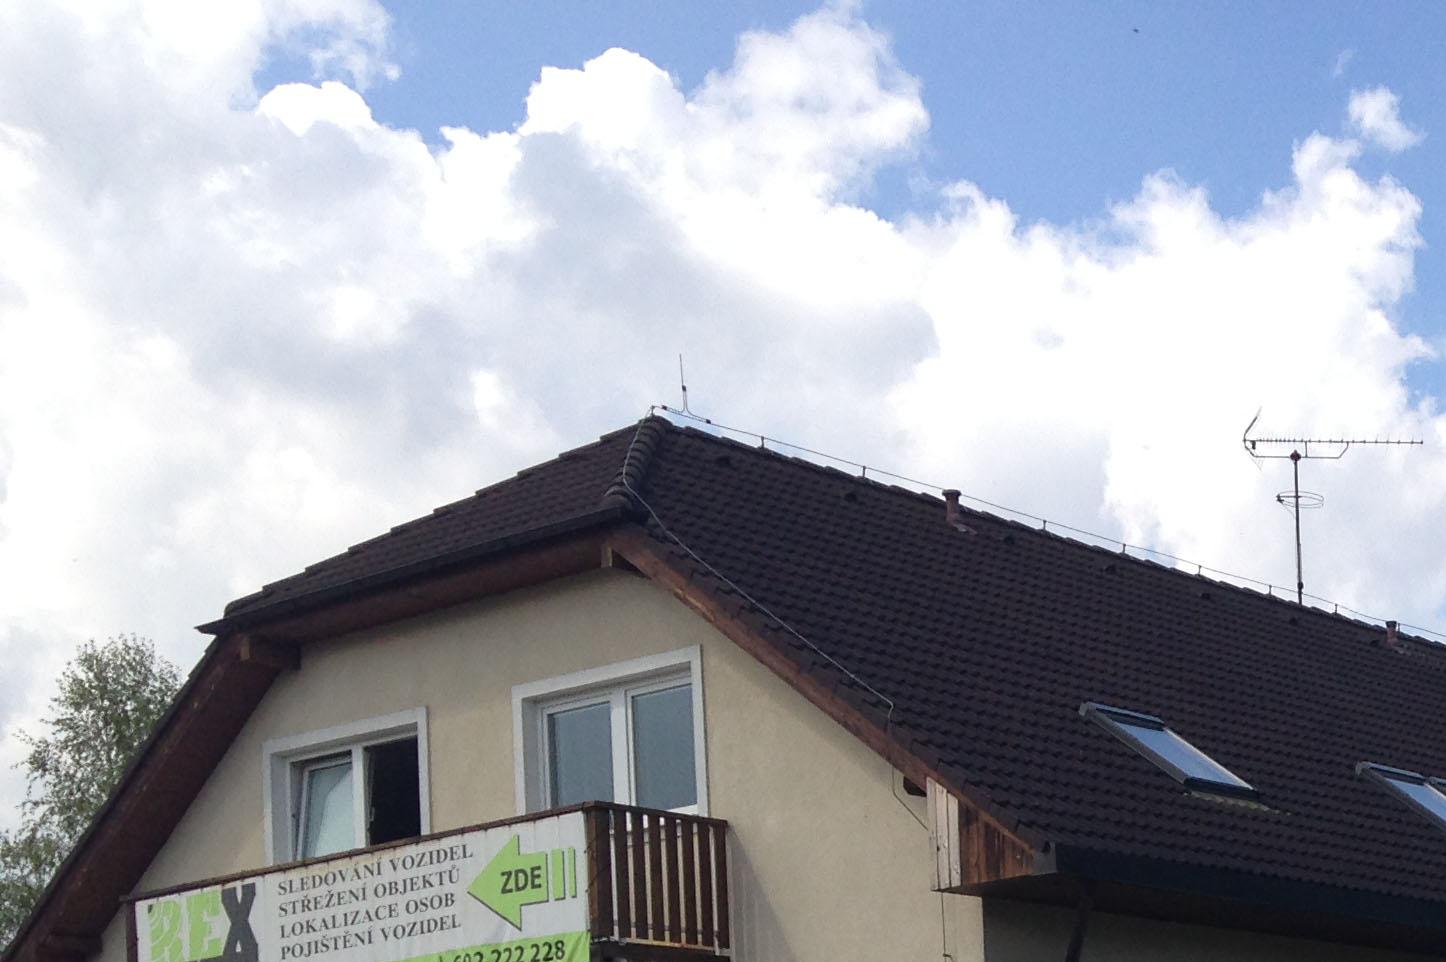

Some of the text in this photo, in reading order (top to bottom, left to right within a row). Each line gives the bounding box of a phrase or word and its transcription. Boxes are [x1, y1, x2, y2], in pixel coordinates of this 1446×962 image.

[278, 844, 474, 896] SLEDOVÁNÍ VOZIDEL
[278, 864, 460, 918] STŘEŽENÍ OBJEKTŮ
[500, 865, 542, 895] ZDE
[280, 892, 456, 939] LOKALIZACE OSOB
[281, 914, 461, 960] POJIŠTĚNÍ VOZIDEL
